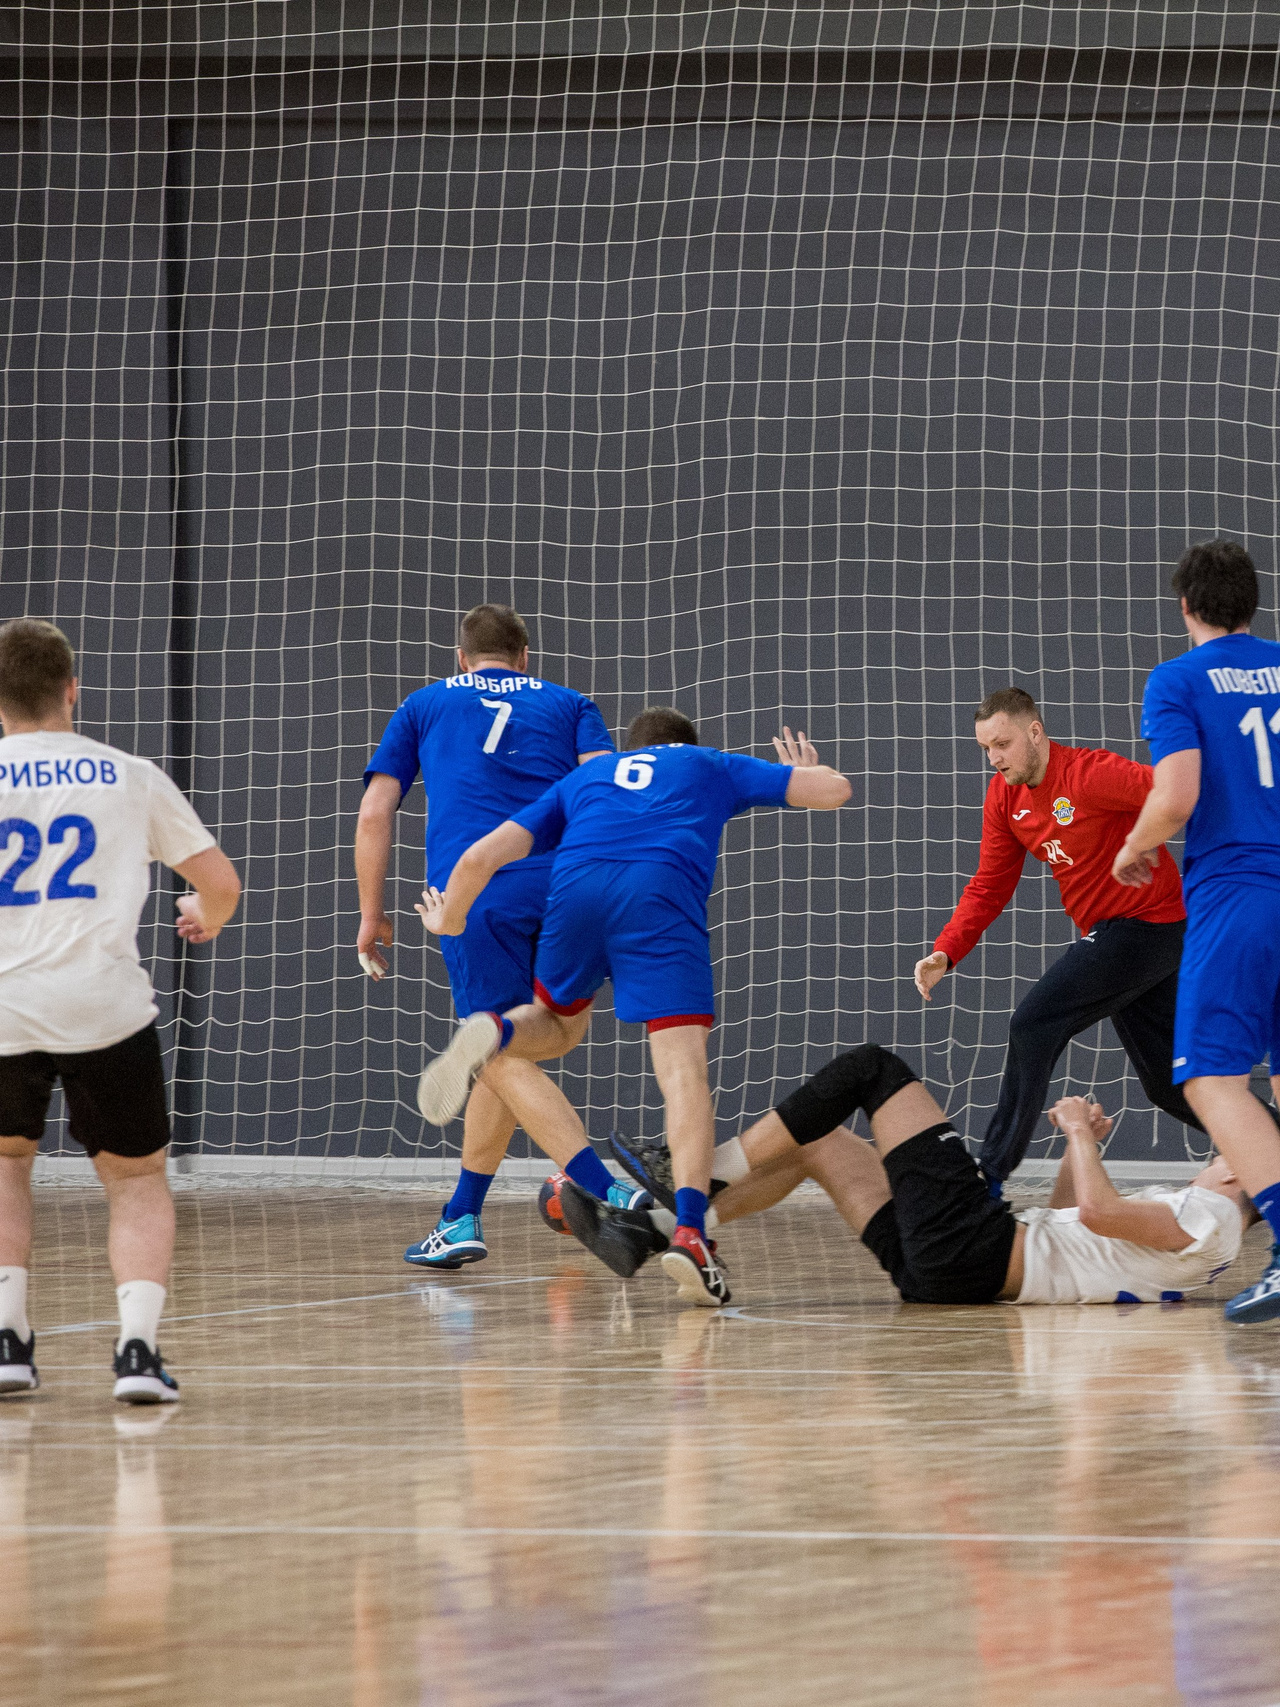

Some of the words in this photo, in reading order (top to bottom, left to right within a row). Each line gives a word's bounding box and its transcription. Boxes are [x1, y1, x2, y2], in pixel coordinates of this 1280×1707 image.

[445, 672, 543, 694] КОВБАРЬ
[480, 697, 513, 754] 7
[613, 753, 657, 790] 6
[0, 814, 97, 907] 22
